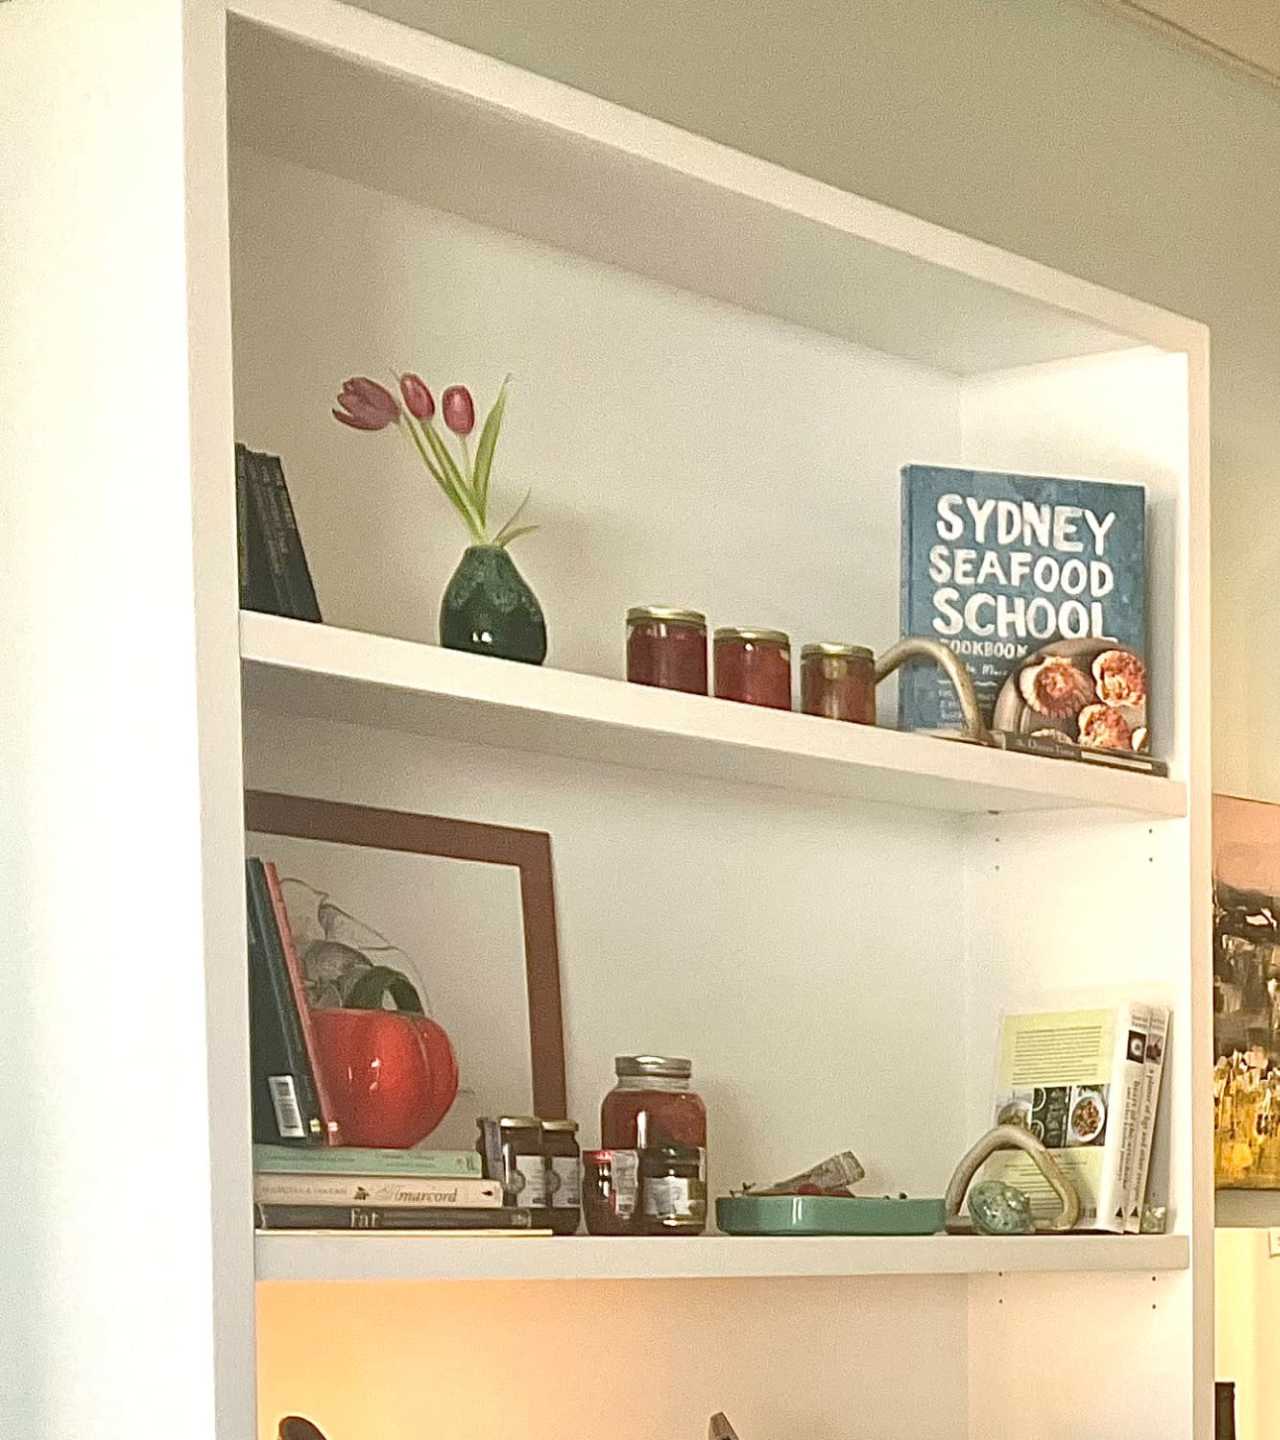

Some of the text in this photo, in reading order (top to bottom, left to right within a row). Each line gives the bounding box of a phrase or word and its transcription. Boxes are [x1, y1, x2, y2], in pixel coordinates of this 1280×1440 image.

[936, 494, 1116, 557] SYDNEY
[929, 544, 1114, 598] SEAFOOD
[932, 587, 1118, 644] SCHOOL
[349, 1210, 382, 1228] Fat
